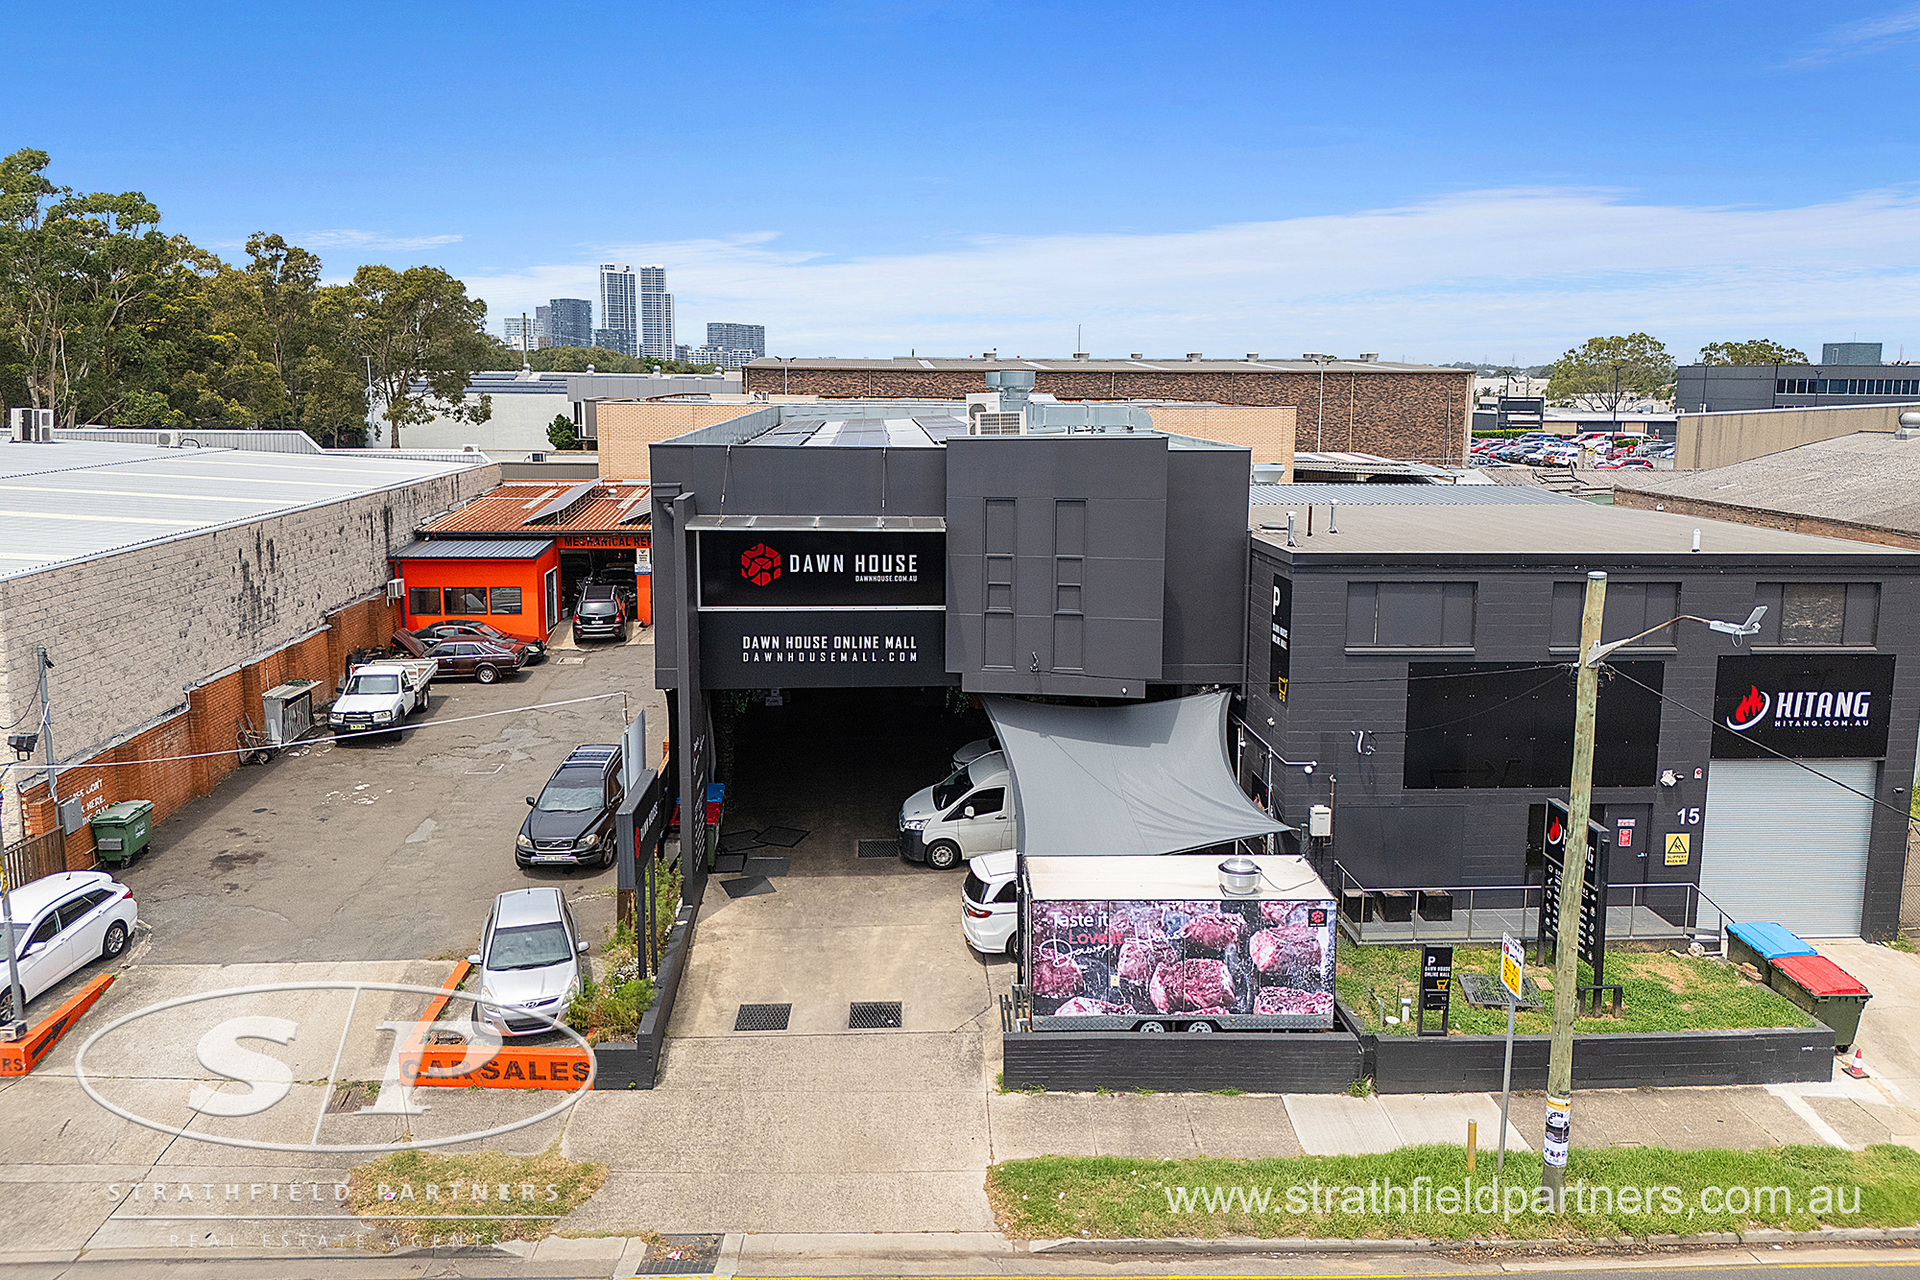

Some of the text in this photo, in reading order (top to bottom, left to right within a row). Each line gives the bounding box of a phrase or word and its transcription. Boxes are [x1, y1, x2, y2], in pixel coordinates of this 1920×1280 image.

[564, 536, 631, 546] MECHANICAL
[789, 554, 918, 573] DAWN HOUSE
[1272, 585, 1280, 616] P
[742, 636, 917, 649] DAWN HOUSE ONLINE MALL
[742, 652, 918, 662] DAWNHOUSEMALL.COM
[1775, 691, 1872, 718] HITANG
[1677, 807, 1700, 825] 15
[1050, 911, 1109, 928] Taste it
[1038, 920, 1193, 967] Dawn House
[1068, 929, 1108, 945] Love
[1427, 955, 1436, 966] P
[401, 1060, 591, 1081] CAR SALES
